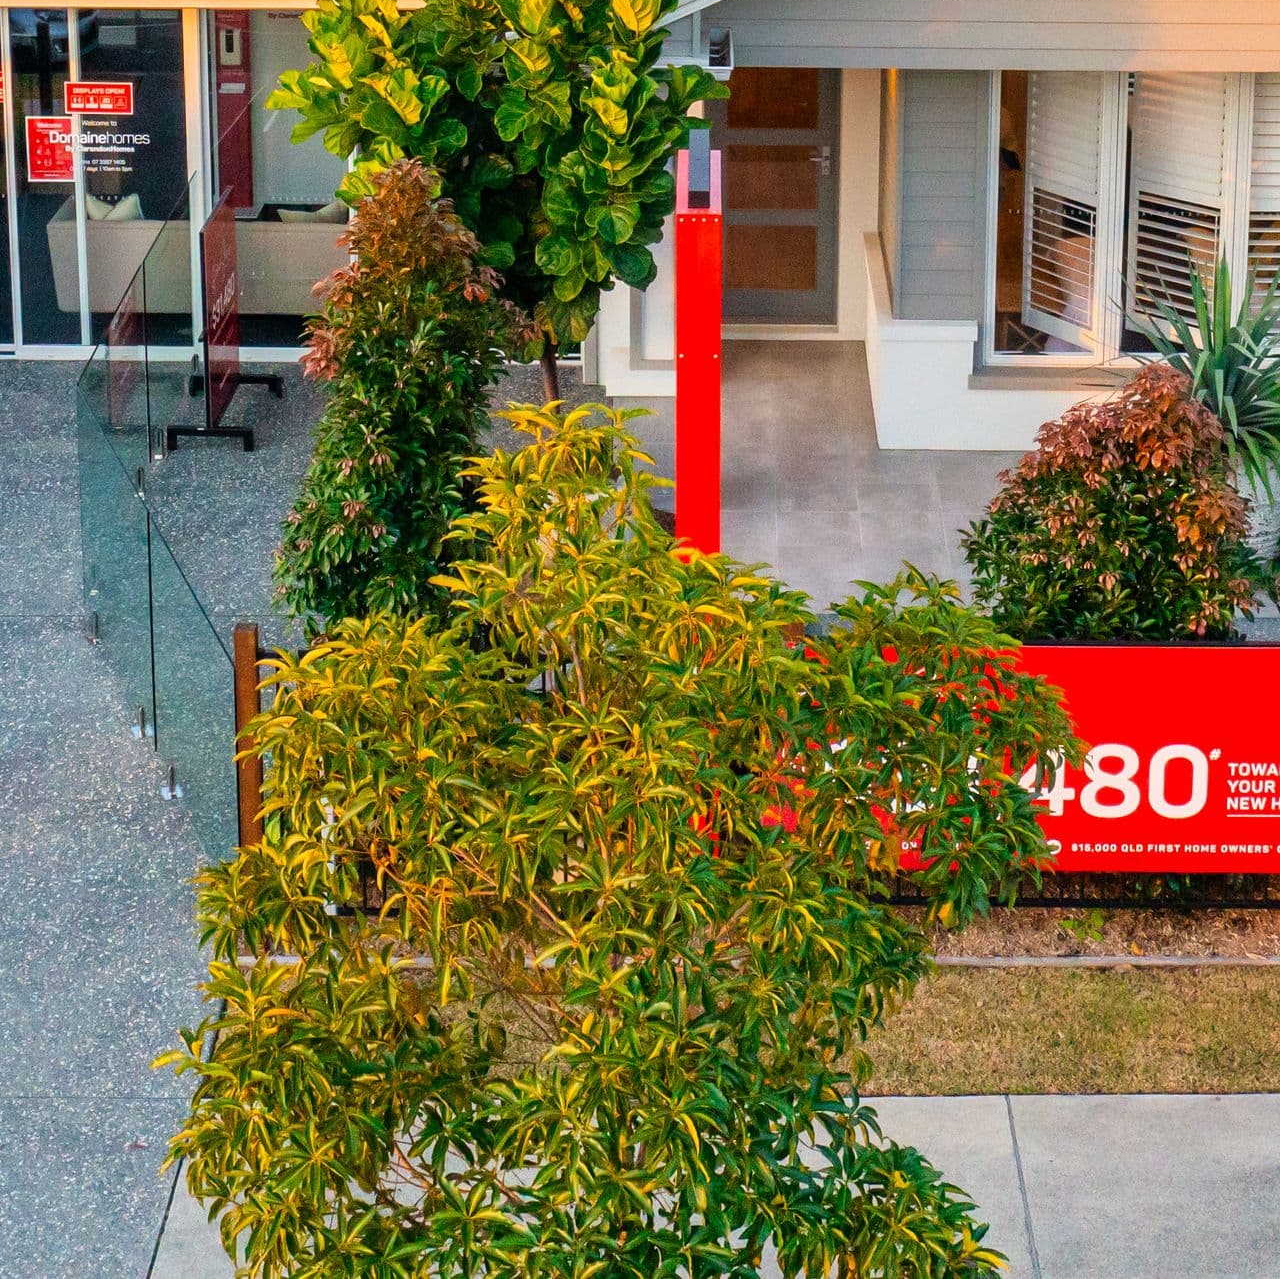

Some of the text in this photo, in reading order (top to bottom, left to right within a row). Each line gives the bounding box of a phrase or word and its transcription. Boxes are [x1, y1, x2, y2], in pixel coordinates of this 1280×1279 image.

[49, 130, 151, 145] Domainehomes
[1227, 779, 1276, 794] YOUR
[1226, 796, 1267, 811] NEW
[1071, 843, 1117, 854] $15,000
[1120, 843, 1144, 853] QLD
[1147, 843, 1181, 853] FIRST
[1184, 844, 1217, 853] HOME
